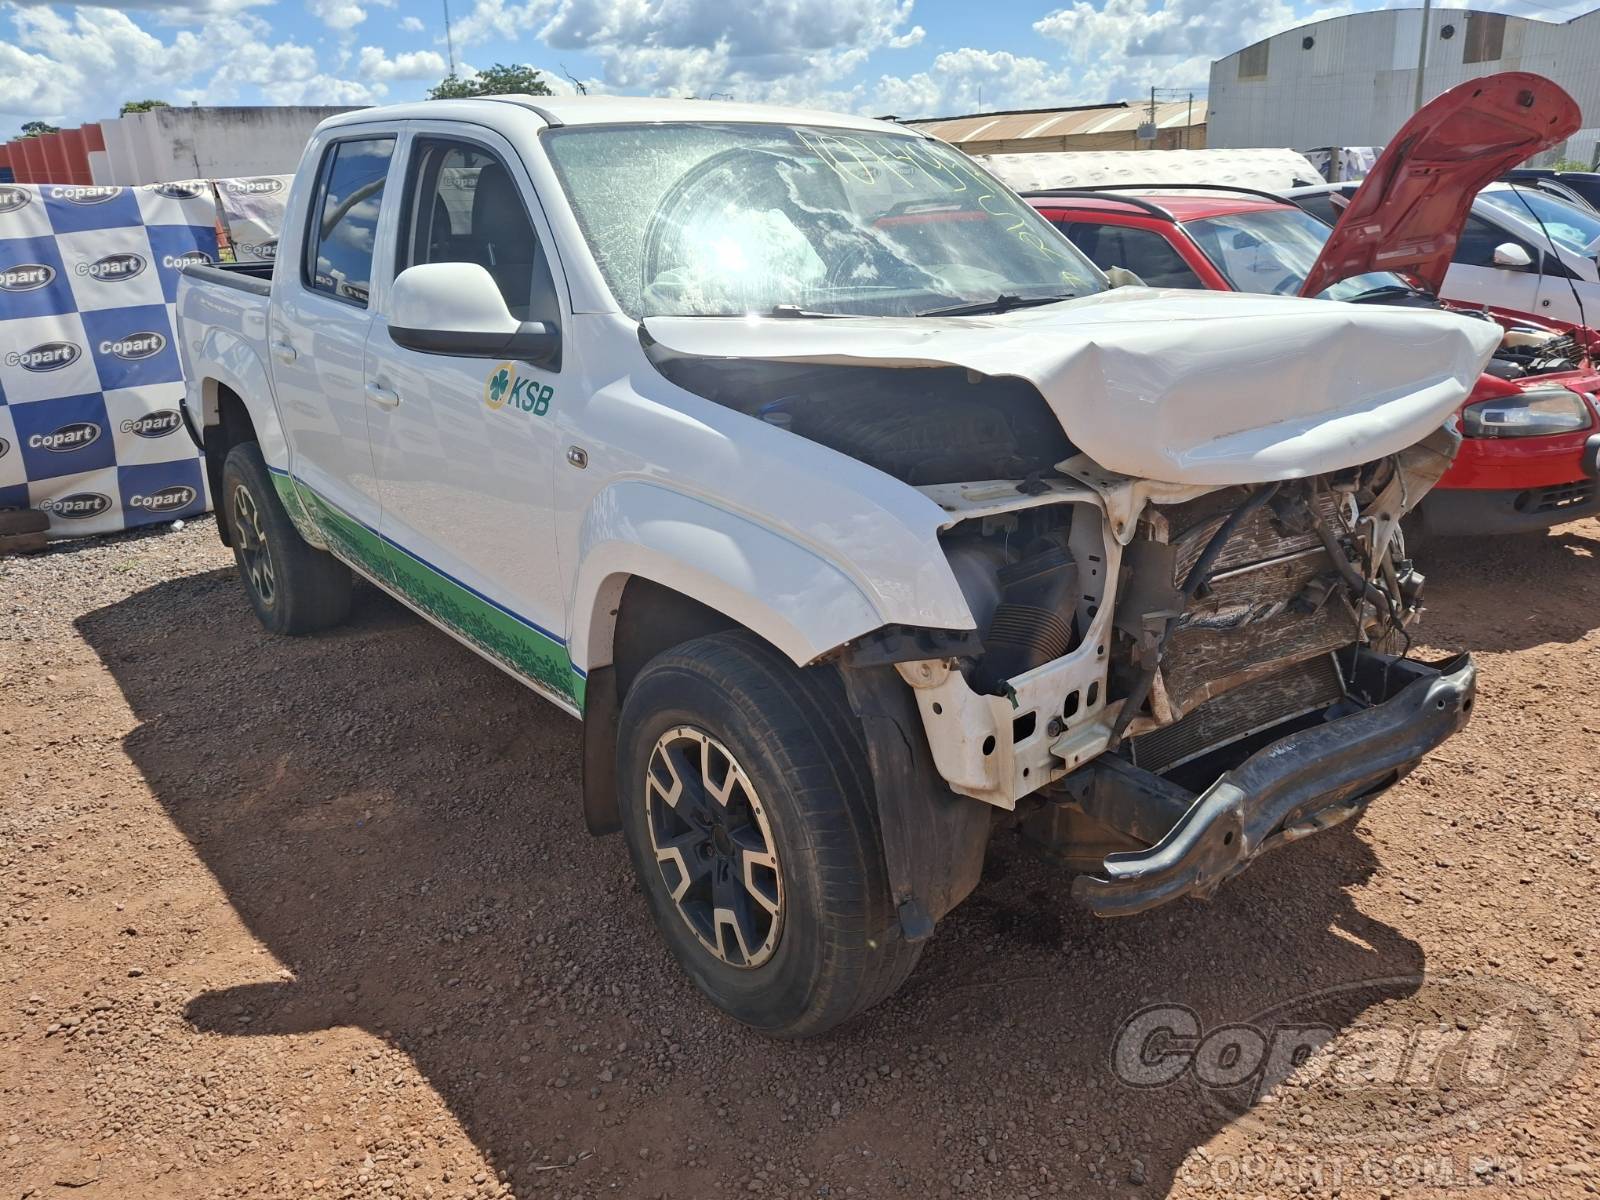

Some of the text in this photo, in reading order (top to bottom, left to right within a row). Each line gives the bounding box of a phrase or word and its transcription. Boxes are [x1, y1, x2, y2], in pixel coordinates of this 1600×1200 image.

[75, 257, 138, 277] Copart
[99, 336, 158, 355] Copart
[5, 345, 71, 367] Copart
[508, 376, 554, 416] KSB
[120, 413, 178, 434] Copart
[29, 426, 92, 448] Copart
[39, 497, 102, 513] Copart
[129, 489, 189, 508] Copart
